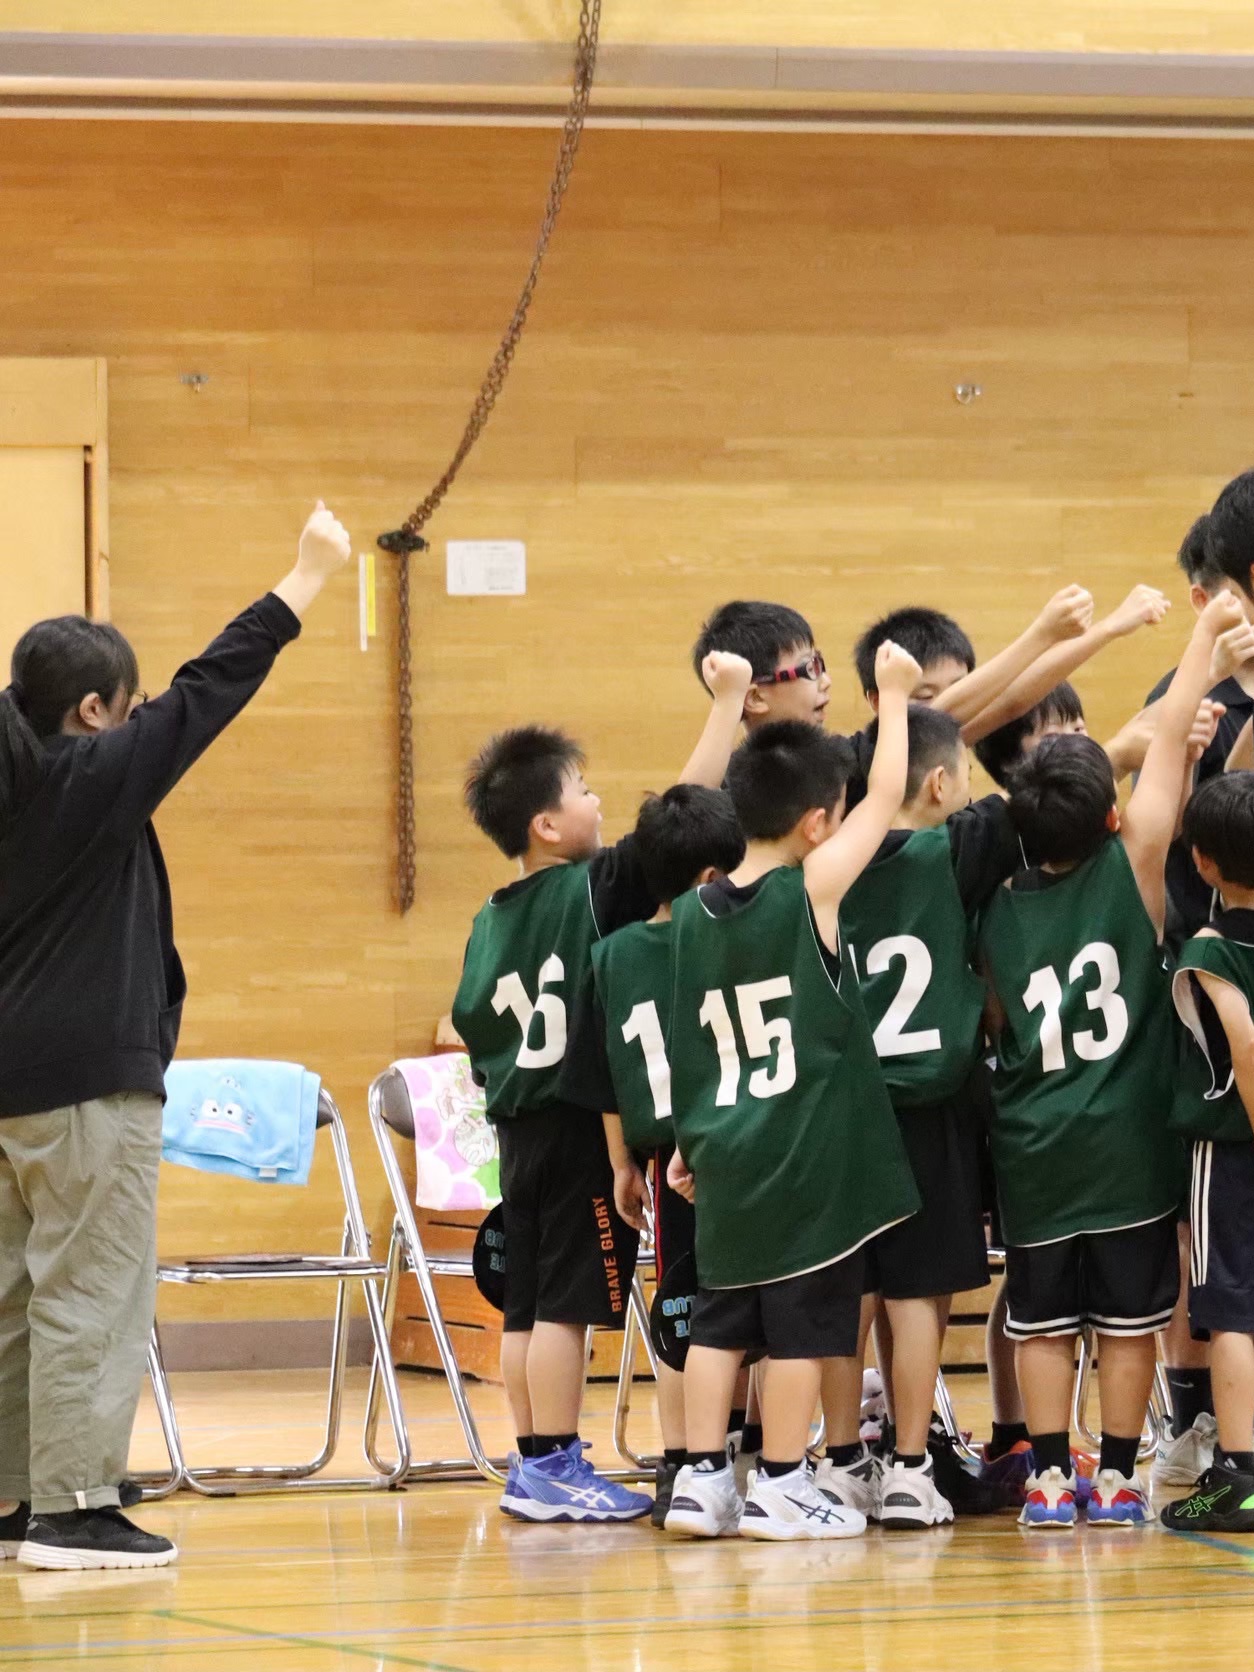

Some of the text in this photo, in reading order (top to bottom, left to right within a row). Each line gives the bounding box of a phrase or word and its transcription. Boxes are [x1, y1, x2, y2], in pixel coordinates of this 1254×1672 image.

[491, 953, 567, 1069] 16
[699, 975, 796, 1107] 15
[848, 935, 942, 1057] 2
[1022, 942, 1129, 1073] 13
[592, 1198, 623, 1312] BRAVE GLORY
